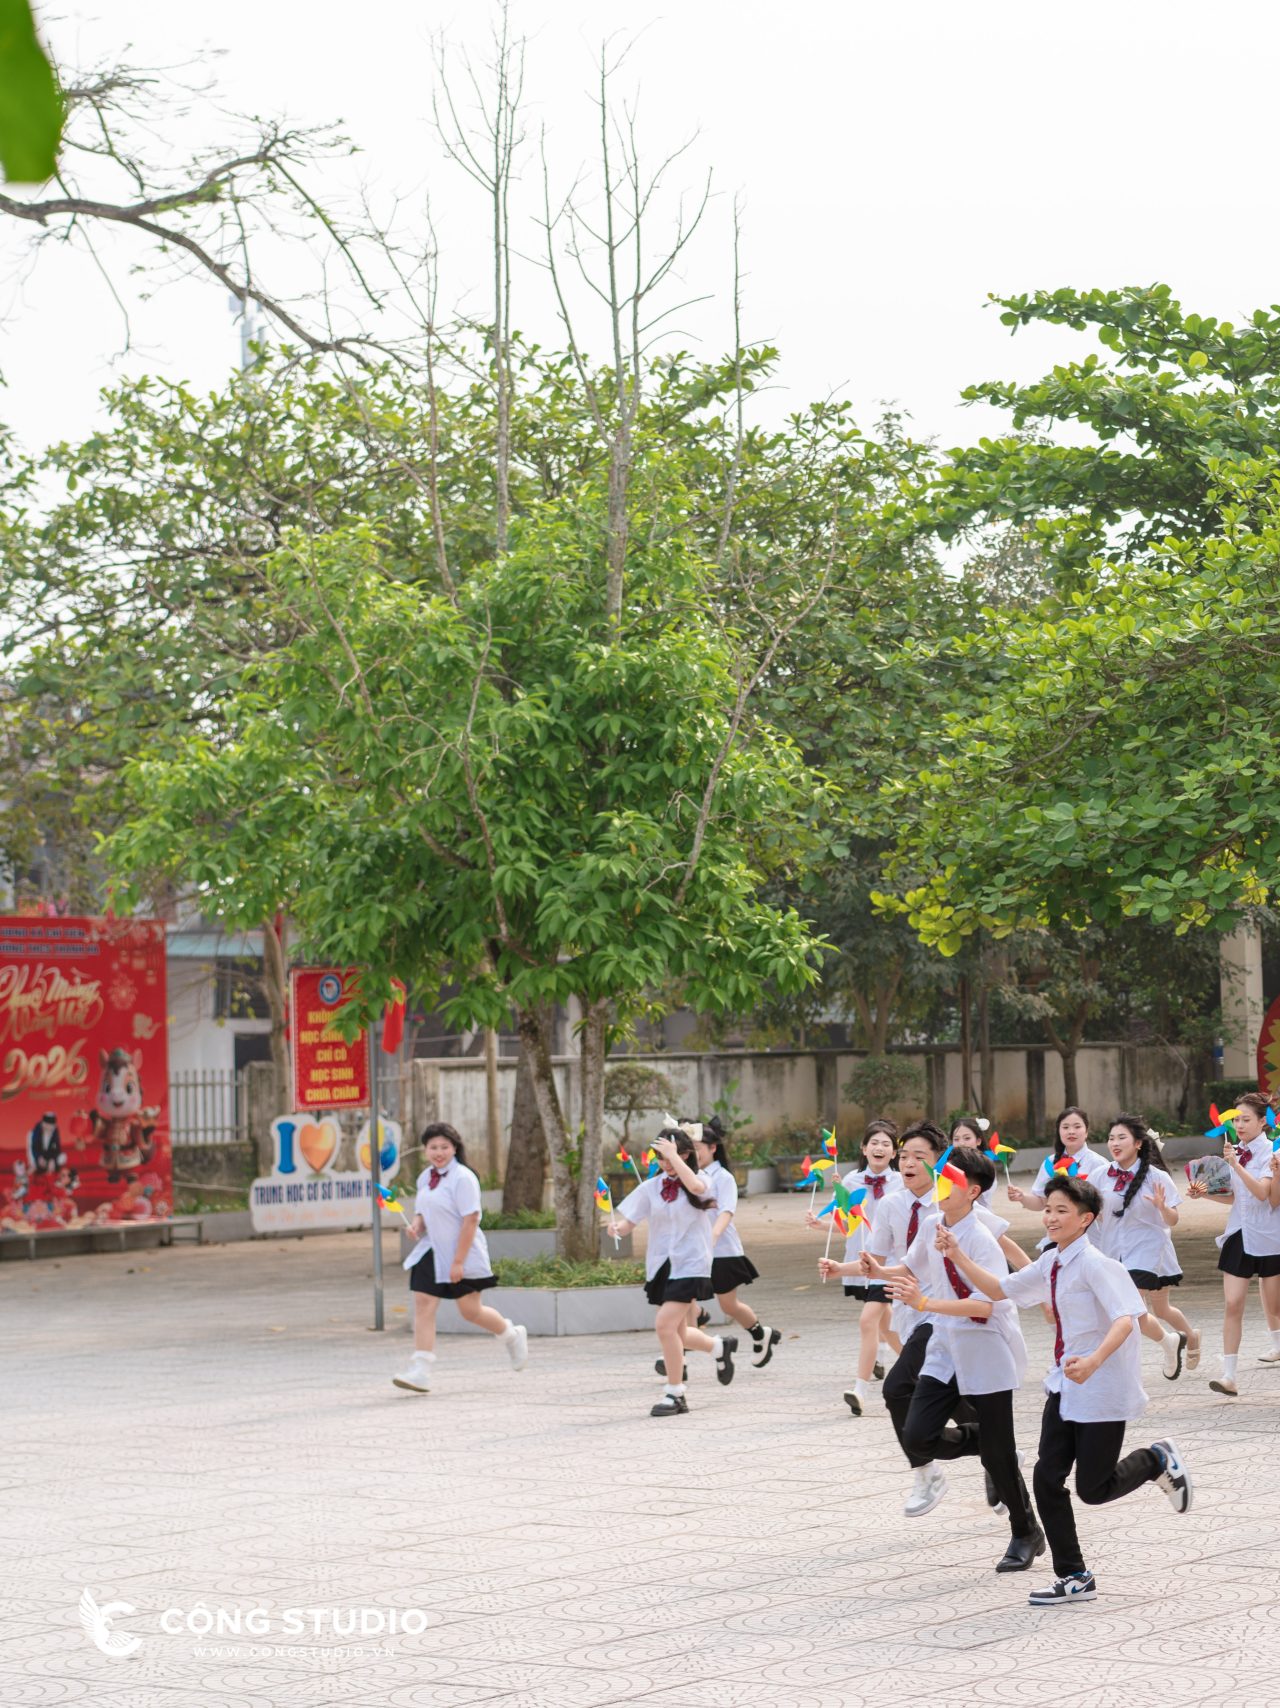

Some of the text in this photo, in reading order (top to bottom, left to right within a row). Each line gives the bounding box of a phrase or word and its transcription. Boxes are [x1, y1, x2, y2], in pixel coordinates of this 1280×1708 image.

[307, 1009, 335, 1024] KHÔN
[300, 1030, 320, 1045] HỌC
[316, 1046, 333, 1062] CHỈ
[2, 1038, 88, 1099] 2026
[310, 1067, 354, 1084] HỌC SINH
[305, 1087, 331, 1102] CHƯA
[277, 1122, 296, 1173] I
[255, 1185, 282, 1205] TRUNG
[286, 1185, 302, 1206] HỌC
[336, 1179, 362, 1198] THANH
[366, 1179, 373, 1197] H
